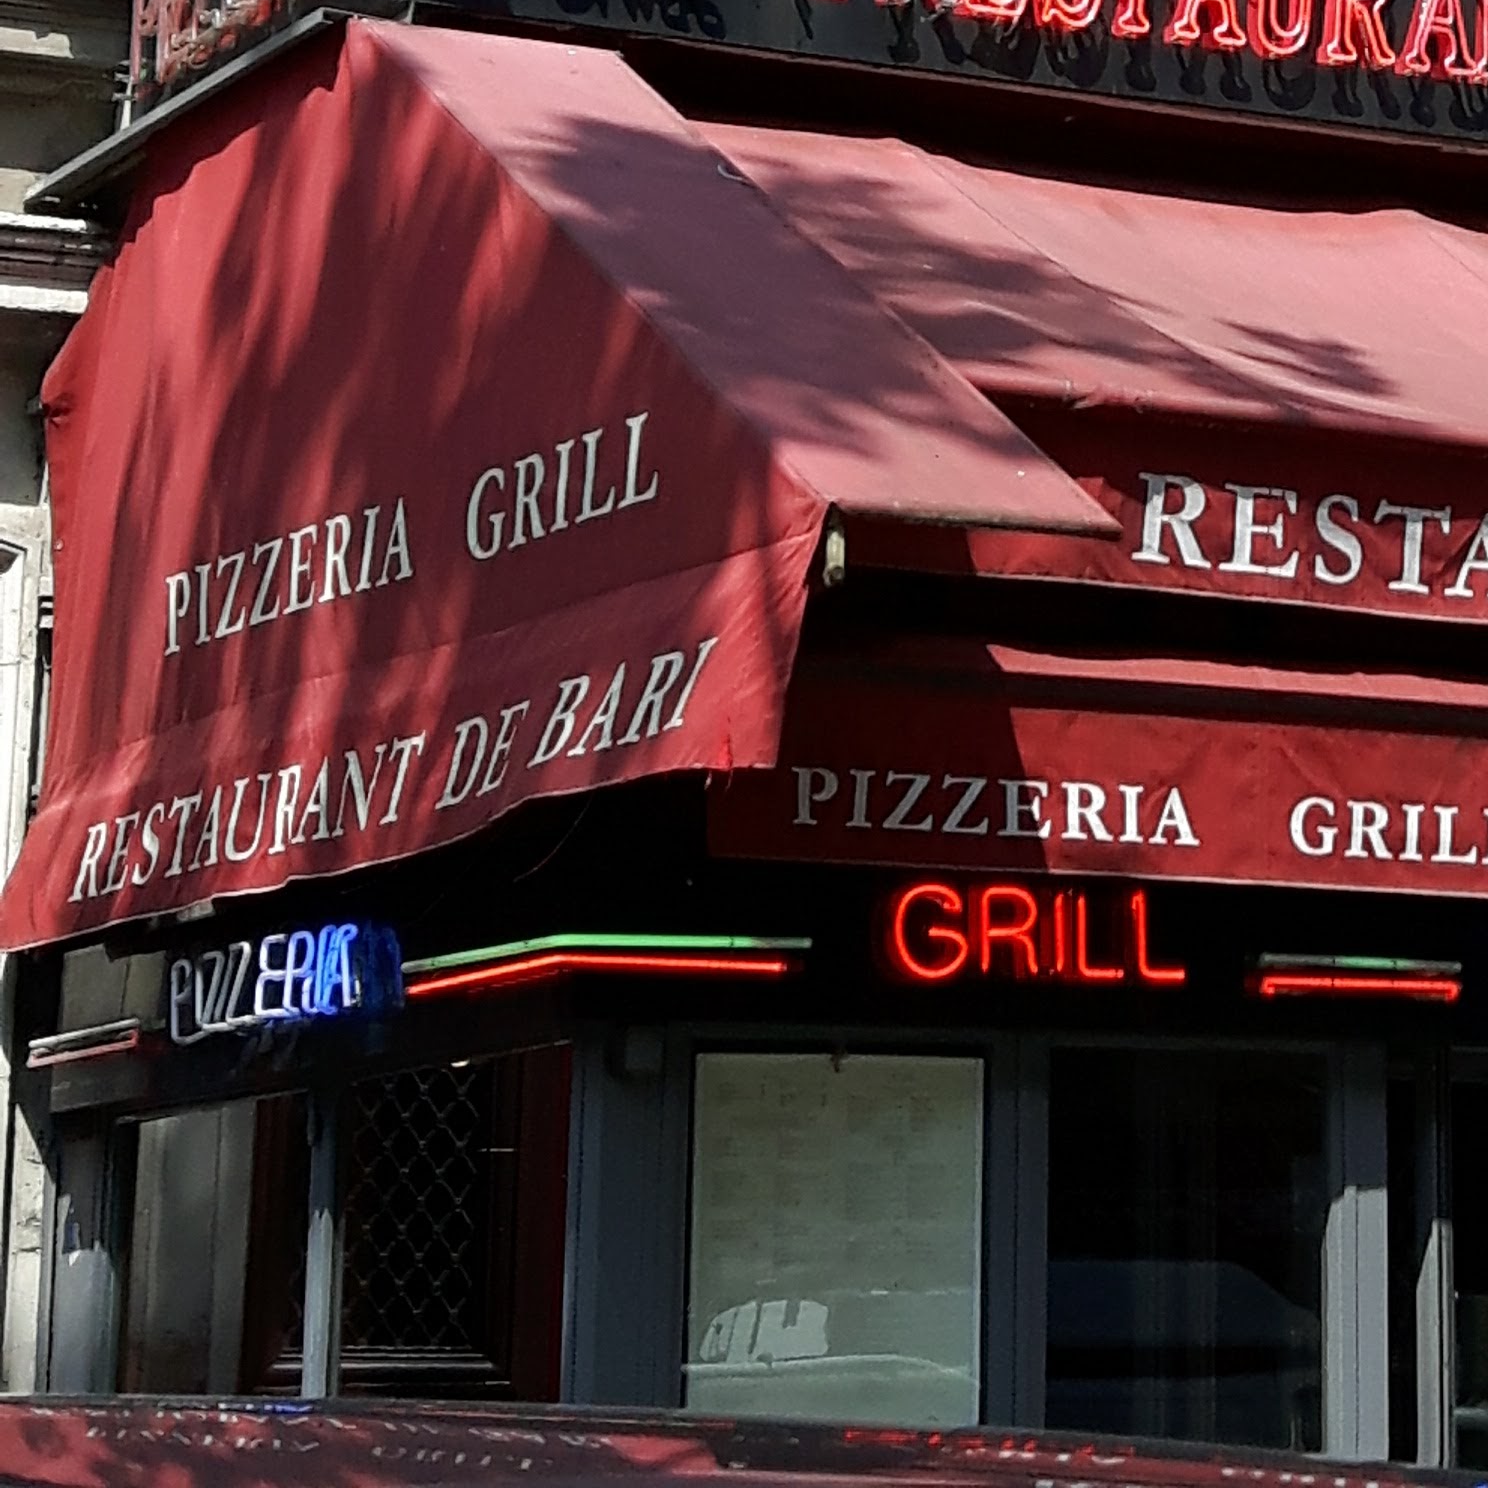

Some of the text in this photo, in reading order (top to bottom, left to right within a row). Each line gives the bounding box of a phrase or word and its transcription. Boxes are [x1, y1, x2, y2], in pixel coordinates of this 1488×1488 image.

[164, 412, 659, 657] PIZZERIA GRILL
[67, 636, 717, 903] RESTAURANT DE BARI
[791, 766, 1200, 847] PIZZERIA
[171, 923, 362, 1045] PIZZERIA
[894, 883, 1187, 981] GRILL
